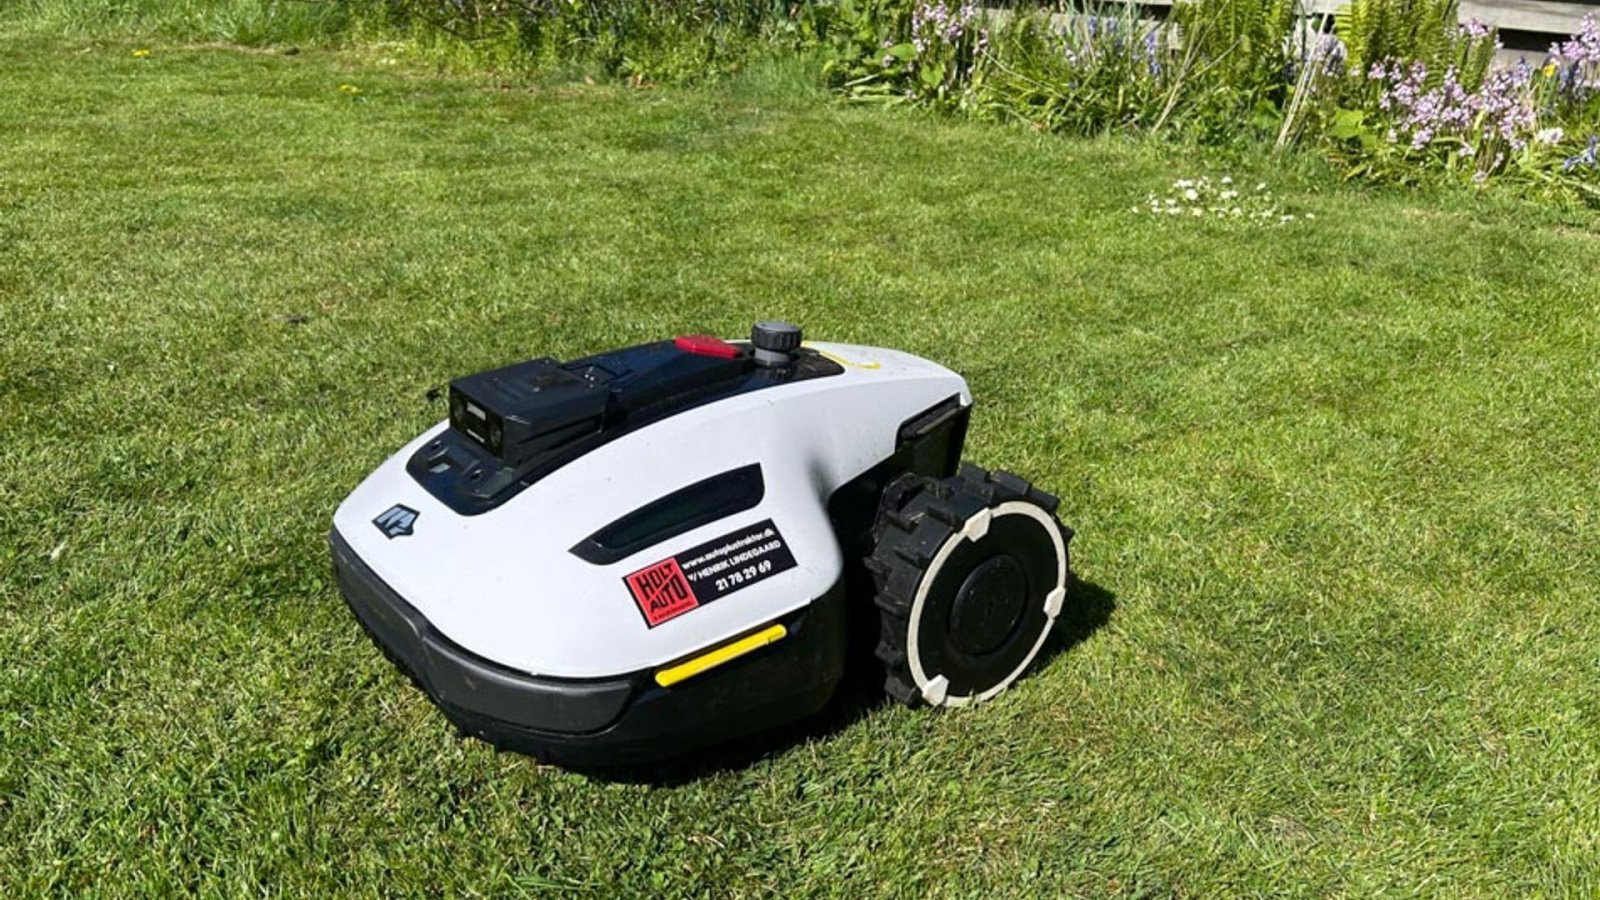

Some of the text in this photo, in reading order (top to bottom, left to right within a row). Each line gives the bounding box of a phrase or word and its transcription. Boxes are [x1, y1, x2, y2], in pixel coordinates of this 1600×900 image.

[697, 560, 730, 579] HENRIK
[729, 540, 781, 566] LINDEGAARD
[715, 560, 771, 591] 21 78 29 69
[635, 562, 673, 601] HOLT
[650, 573, 689, 613] AUTO
